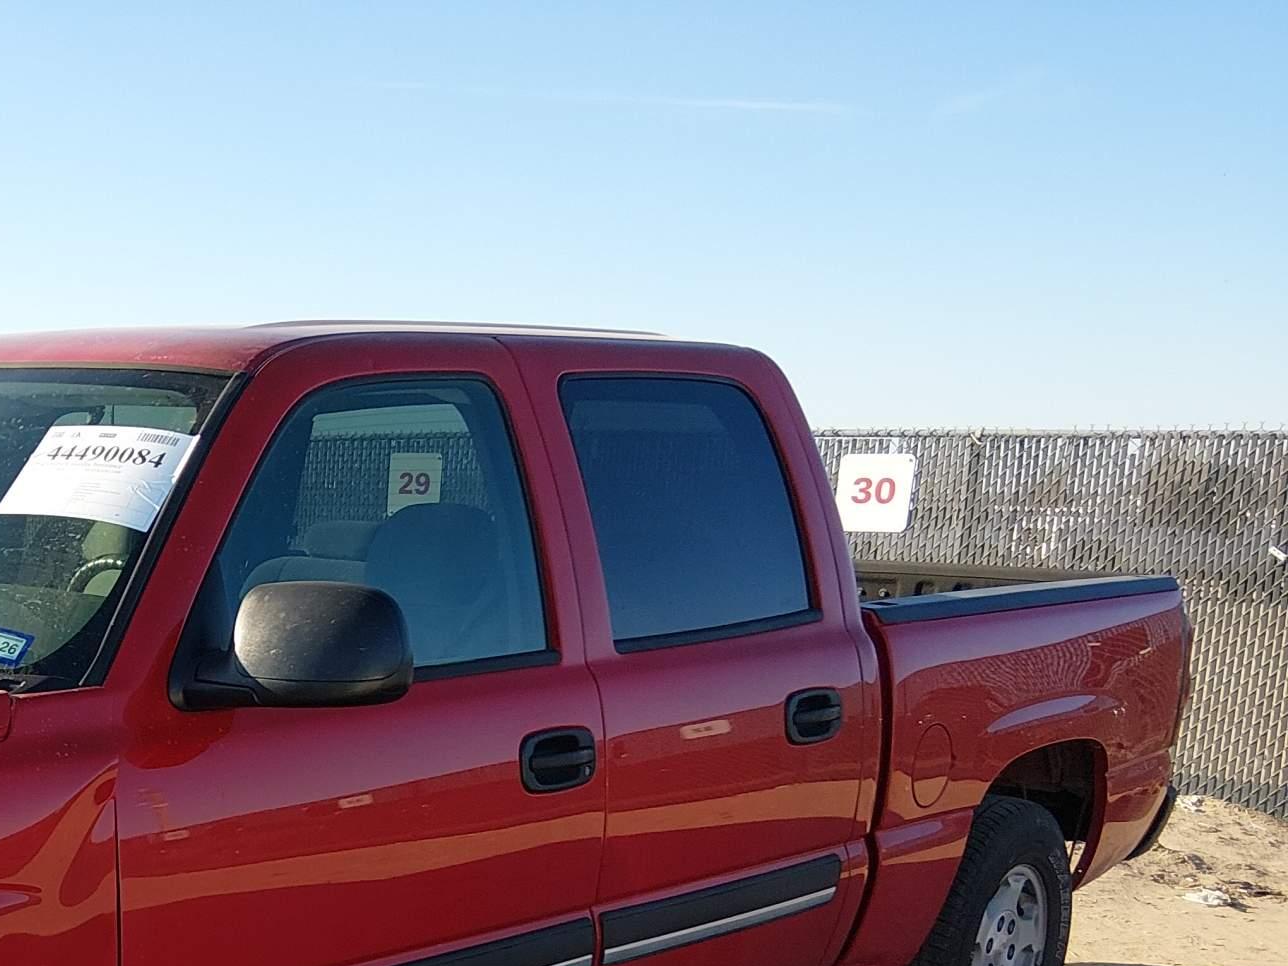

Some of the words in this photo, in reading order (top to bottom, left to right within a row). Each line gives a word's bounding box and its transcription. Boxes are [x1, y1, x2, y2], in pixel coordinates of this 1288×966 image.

[47, 445, 167, 468] 44490084
[399, 472, 430, 495] 29
[851, 477, 896, 504] 30
